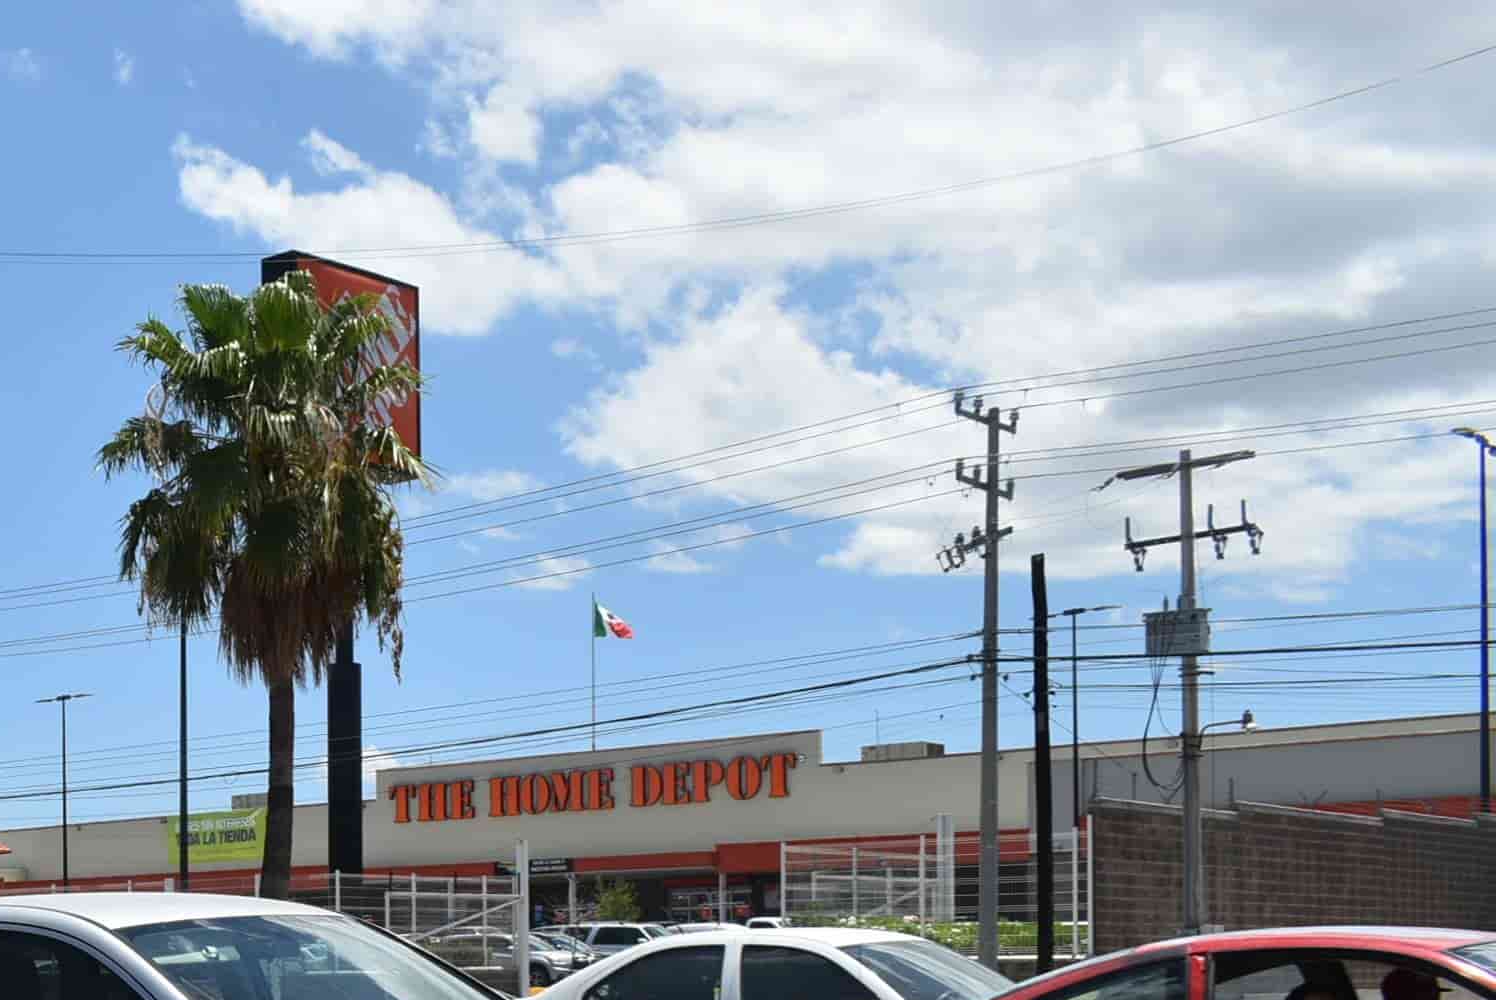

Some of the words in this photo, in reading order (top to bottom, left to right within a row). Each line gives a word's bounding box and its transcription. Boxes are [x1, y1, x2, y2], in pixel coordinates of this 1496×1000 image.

[389, 779, 477, 824] THE
[488, 767, 616, 818] HOME
[629, 752, 797, 807] DEPOT
[202, 832, 216, 845] LA
[218, 828, 256, 843] TIENDA
